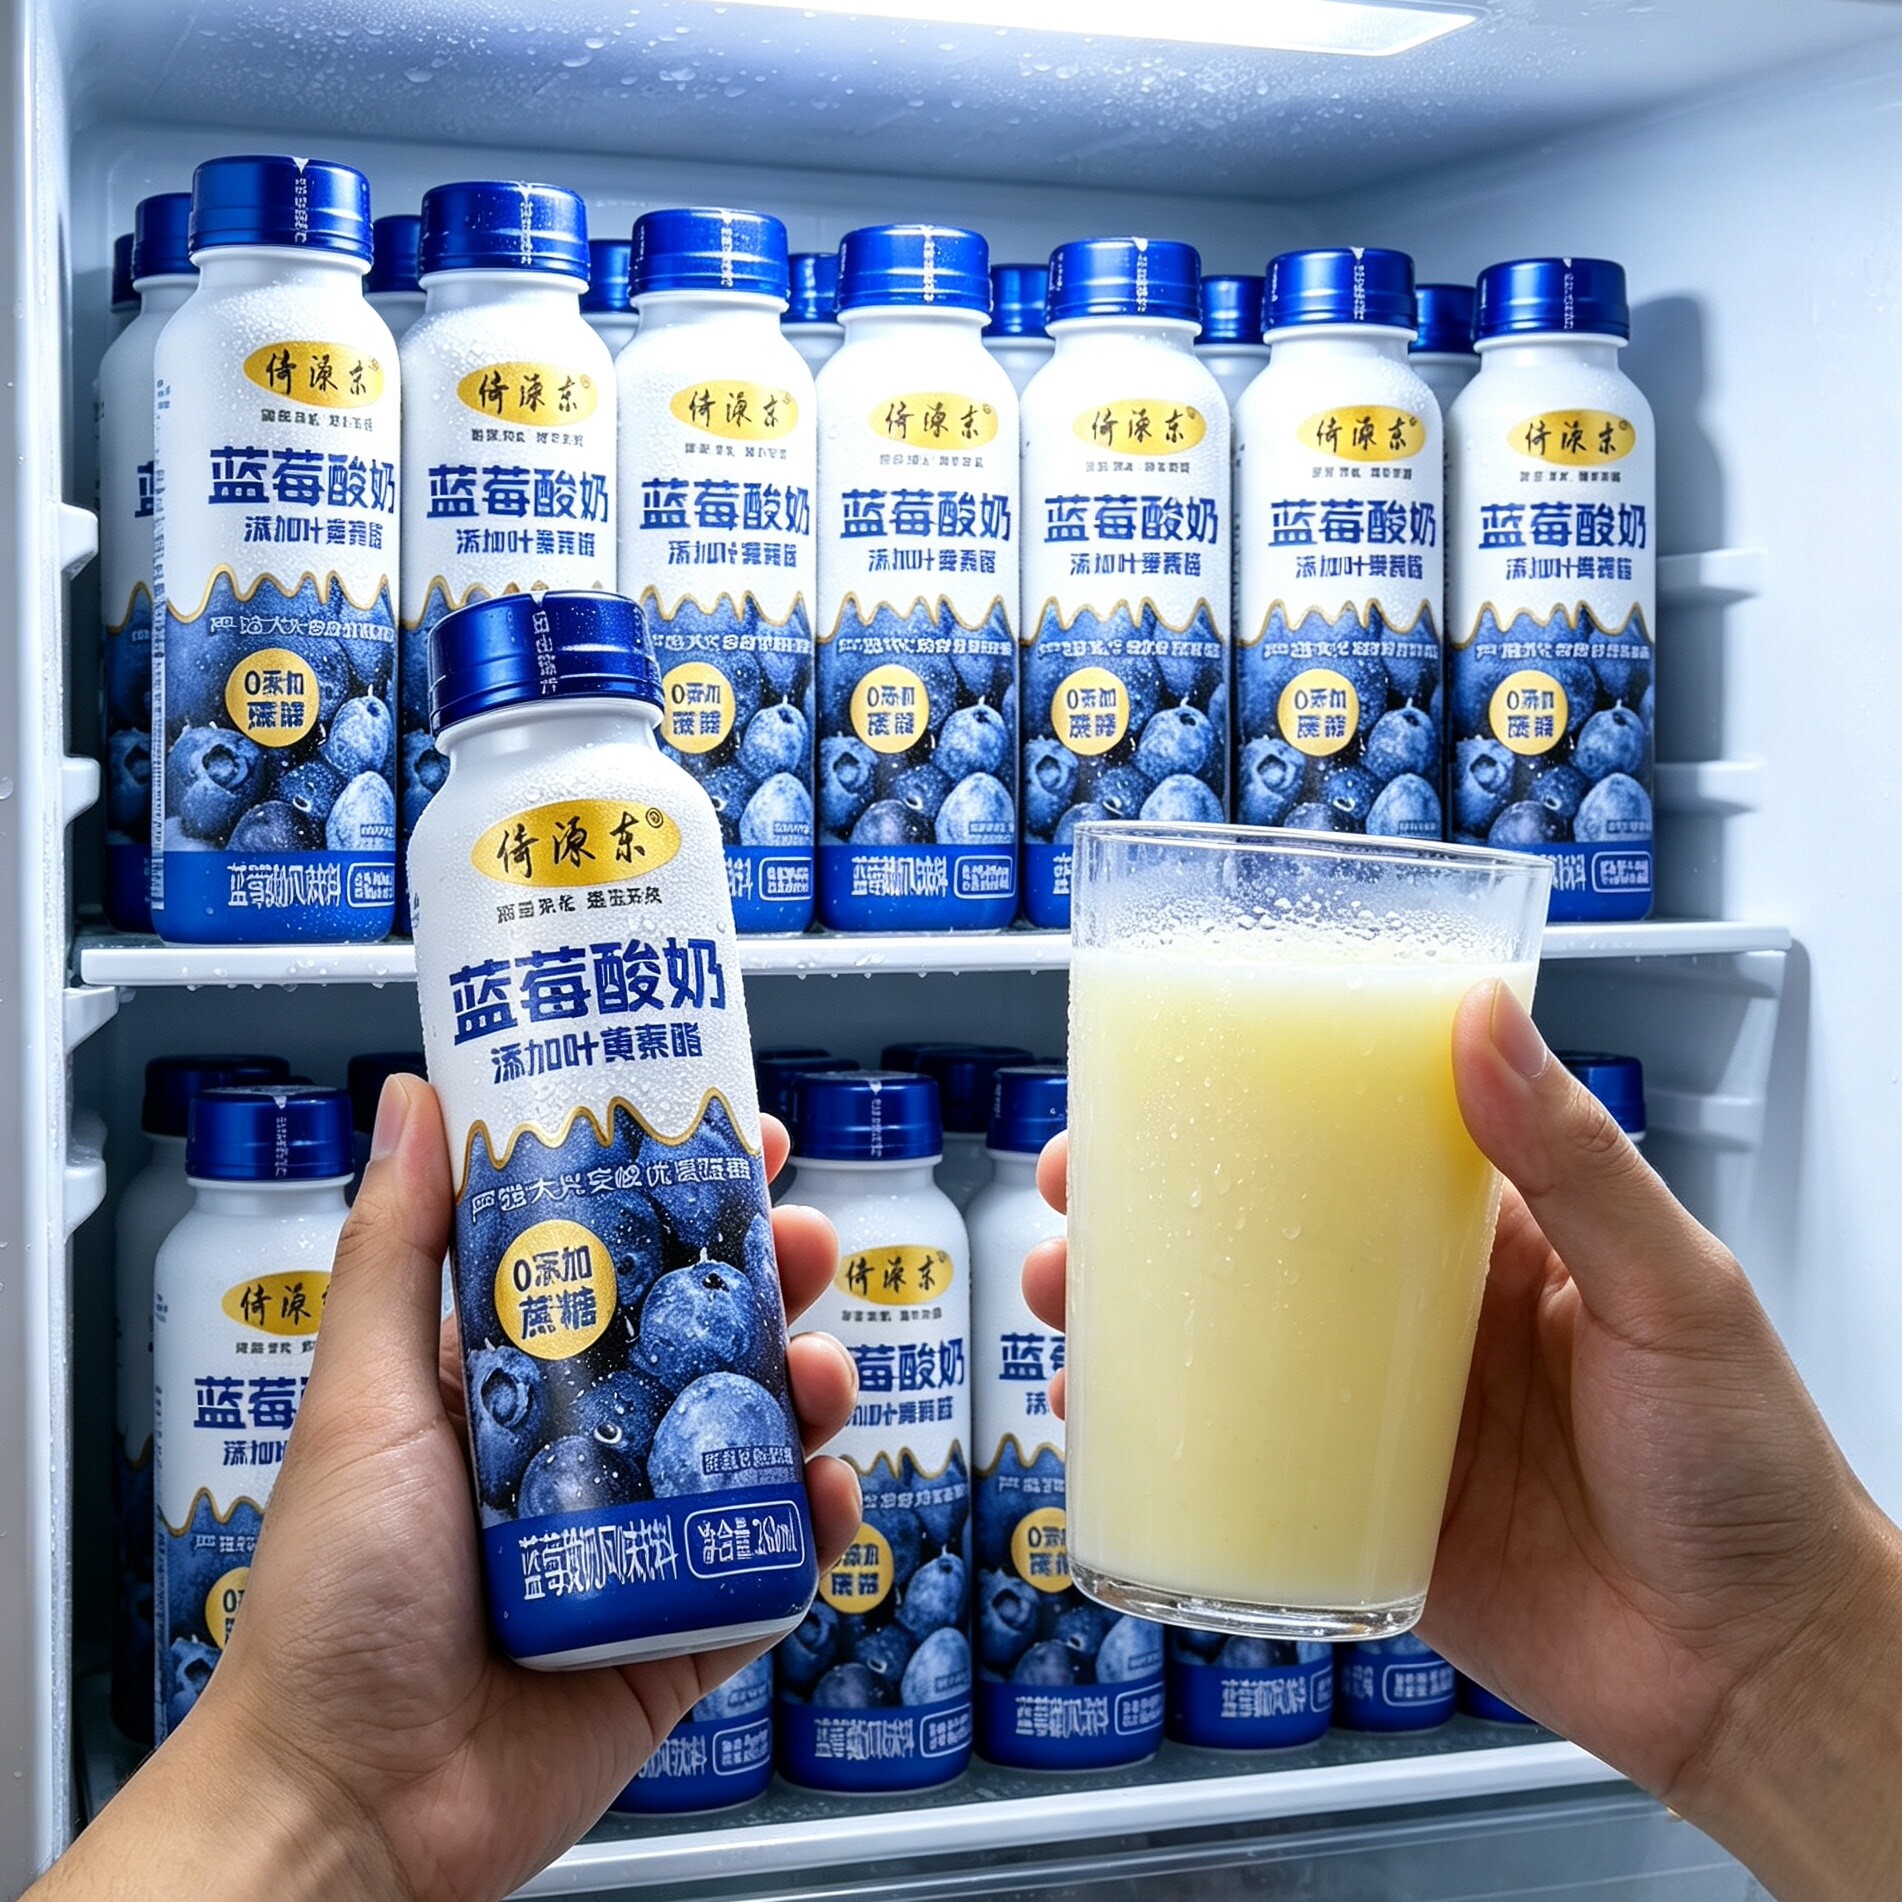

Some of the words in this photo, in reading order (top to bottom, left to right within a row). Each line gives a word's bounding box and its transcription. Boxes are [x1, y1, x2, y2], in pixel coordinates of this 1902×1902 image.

[208, 446, 395, 513] 蓝莓酸奶
[427, 464, 608, 523] 蓝莓酸奶
[639, 477, 810, 536] 蓝莓酸奶
[840, 488, 1011, 541] 蓝莓酸奶
[1044, 494, 1218, 545] 蓝莓酸奶
[1268, 498, 1436, 547] 蓝莓酸奶
[1478, 501, 1646, 549] 蓝莓酸奶
[449, 937, 726, 1046] 蓝莓酸奶
[847, 1337, 964, 1393] 莓酸奶
[194, 1376, 309, 1431] 蓝莓
